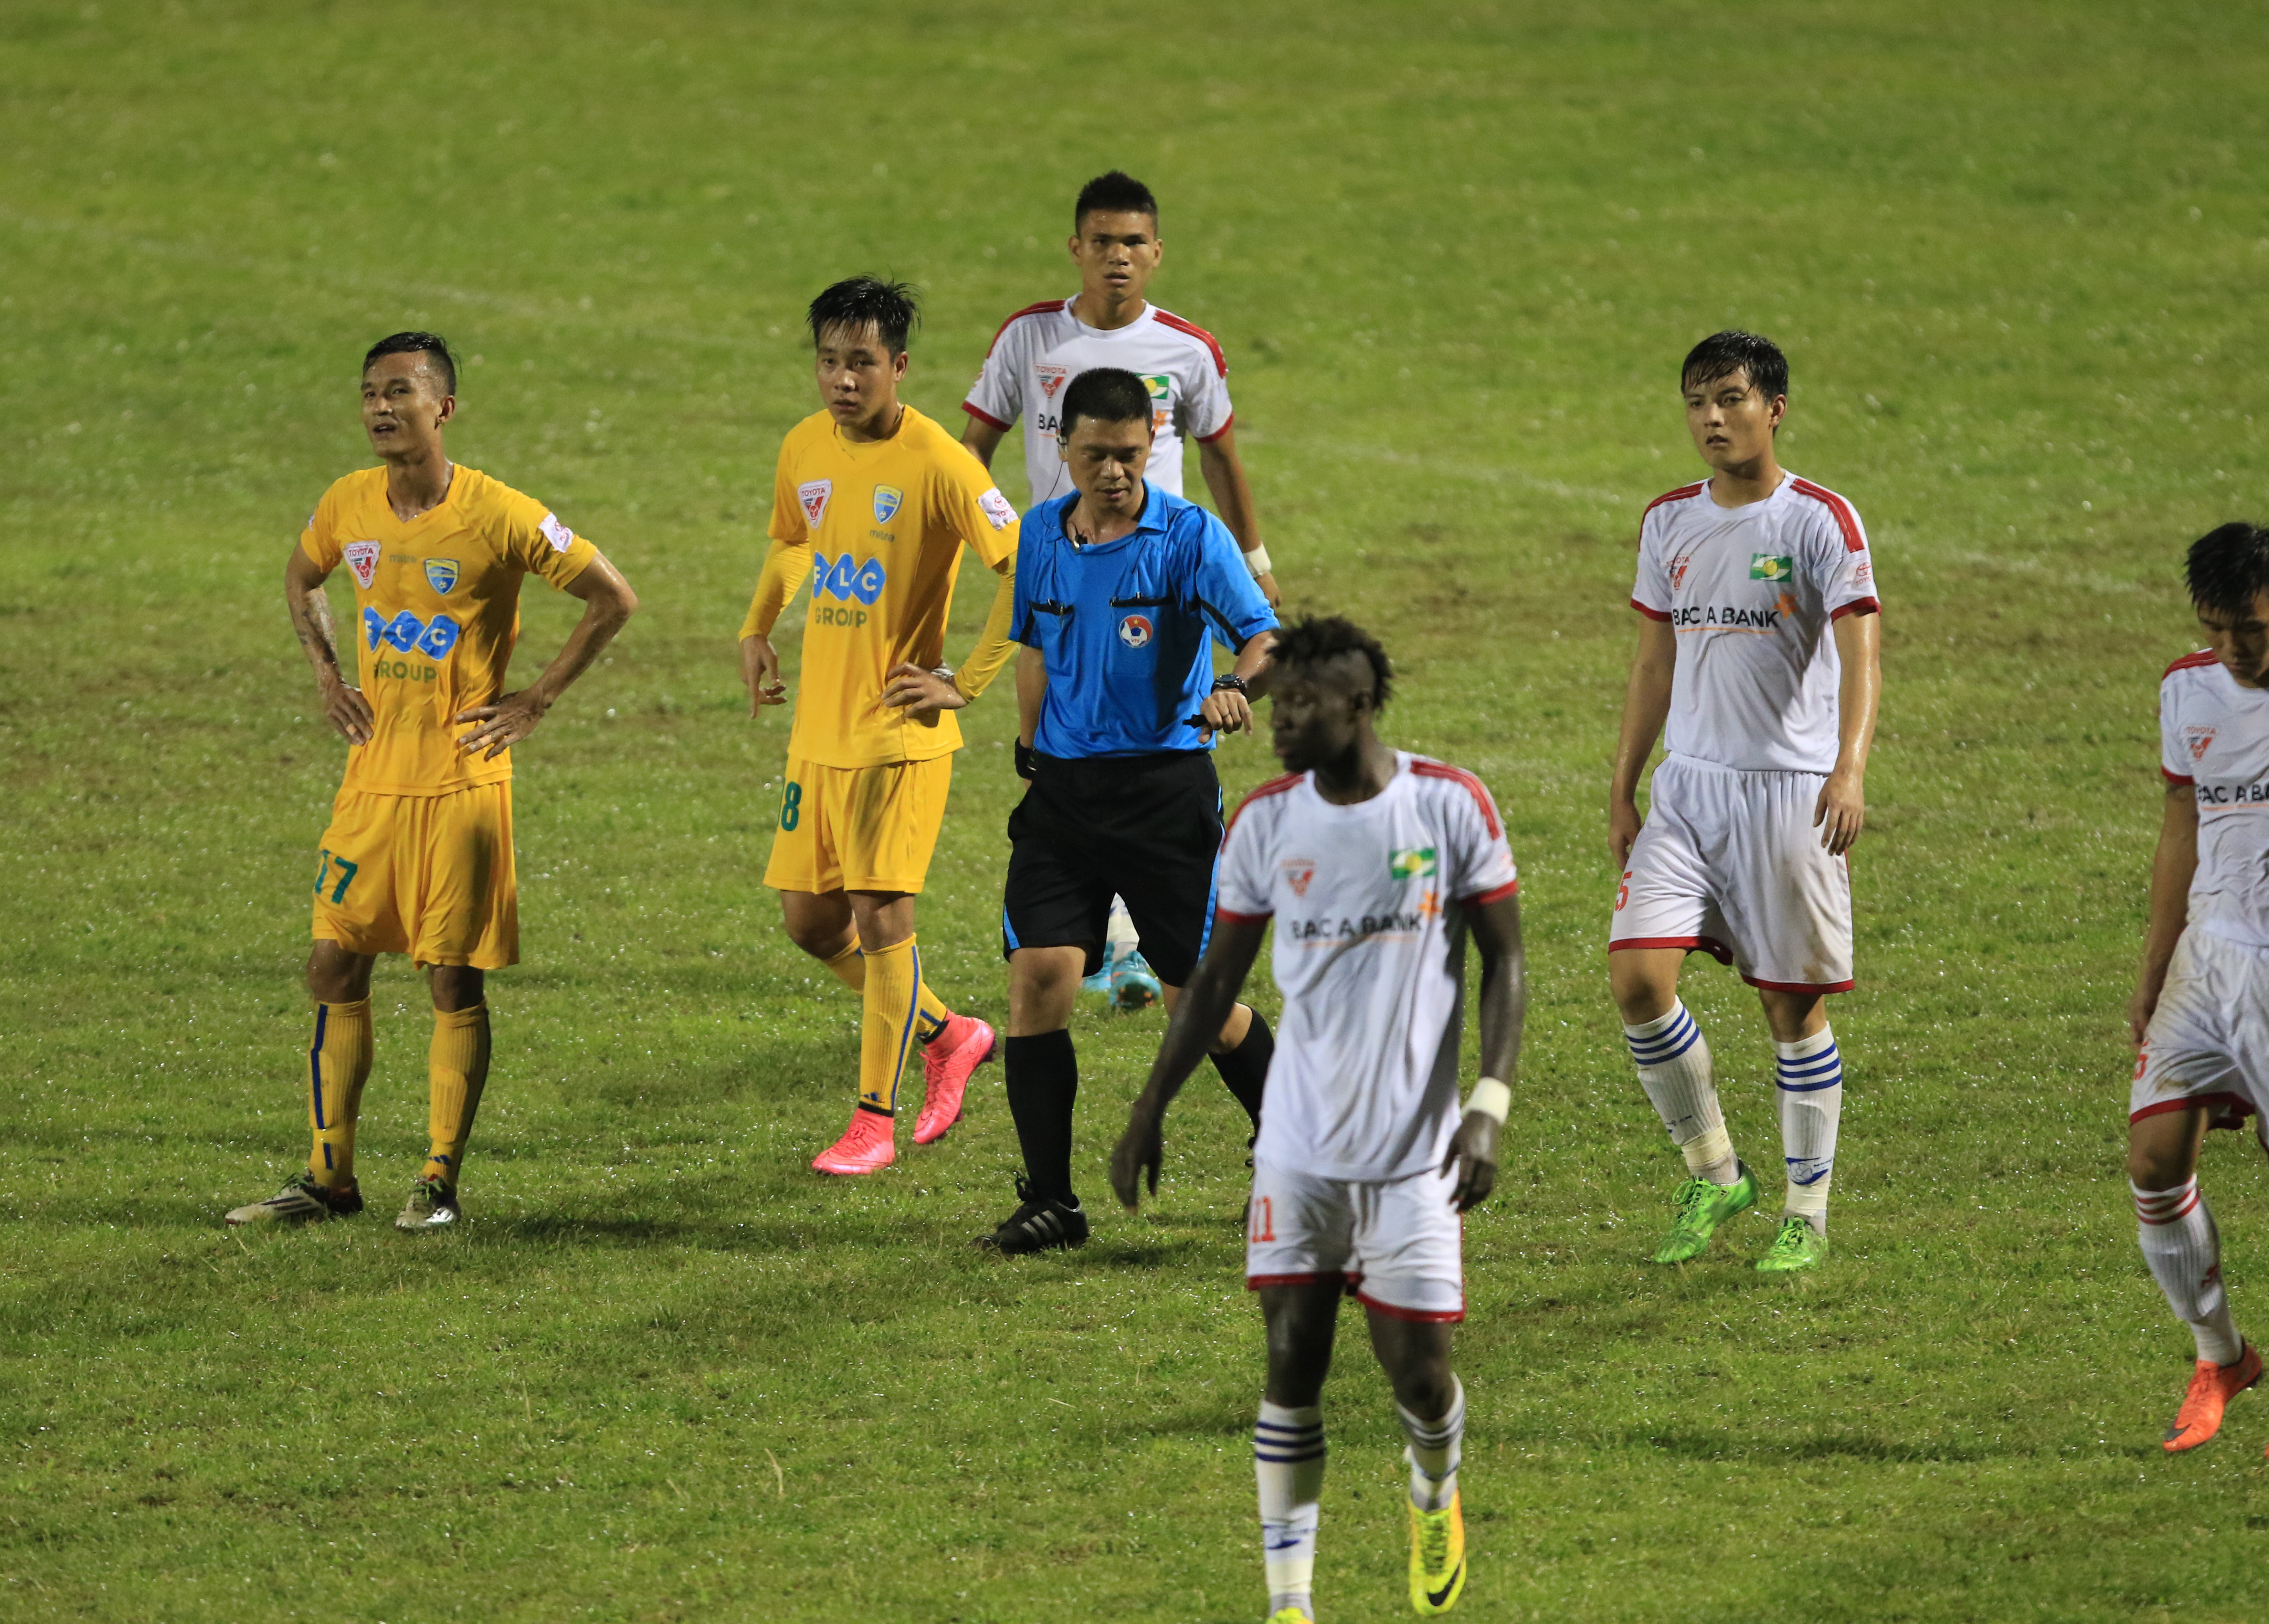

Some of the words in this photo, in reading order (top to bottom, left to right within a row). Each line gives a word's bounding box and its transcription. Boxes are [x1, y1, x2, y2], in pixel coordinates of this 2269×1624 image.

[802, 487, 825, 496] TOYOTA
[348, 548, 374, 556] TOYOTA
[1666, 556, 1690, 566] TOOTA
[814, 566, 877, 591] FLC
[1673, 606, 1701, 625] BAC
[1707, 606, 1717, 624] A
[1722, 607, 1778, 627] BANK
[374, 660, 437, 683] ROUP
[781, 781, 802, 832] 8
